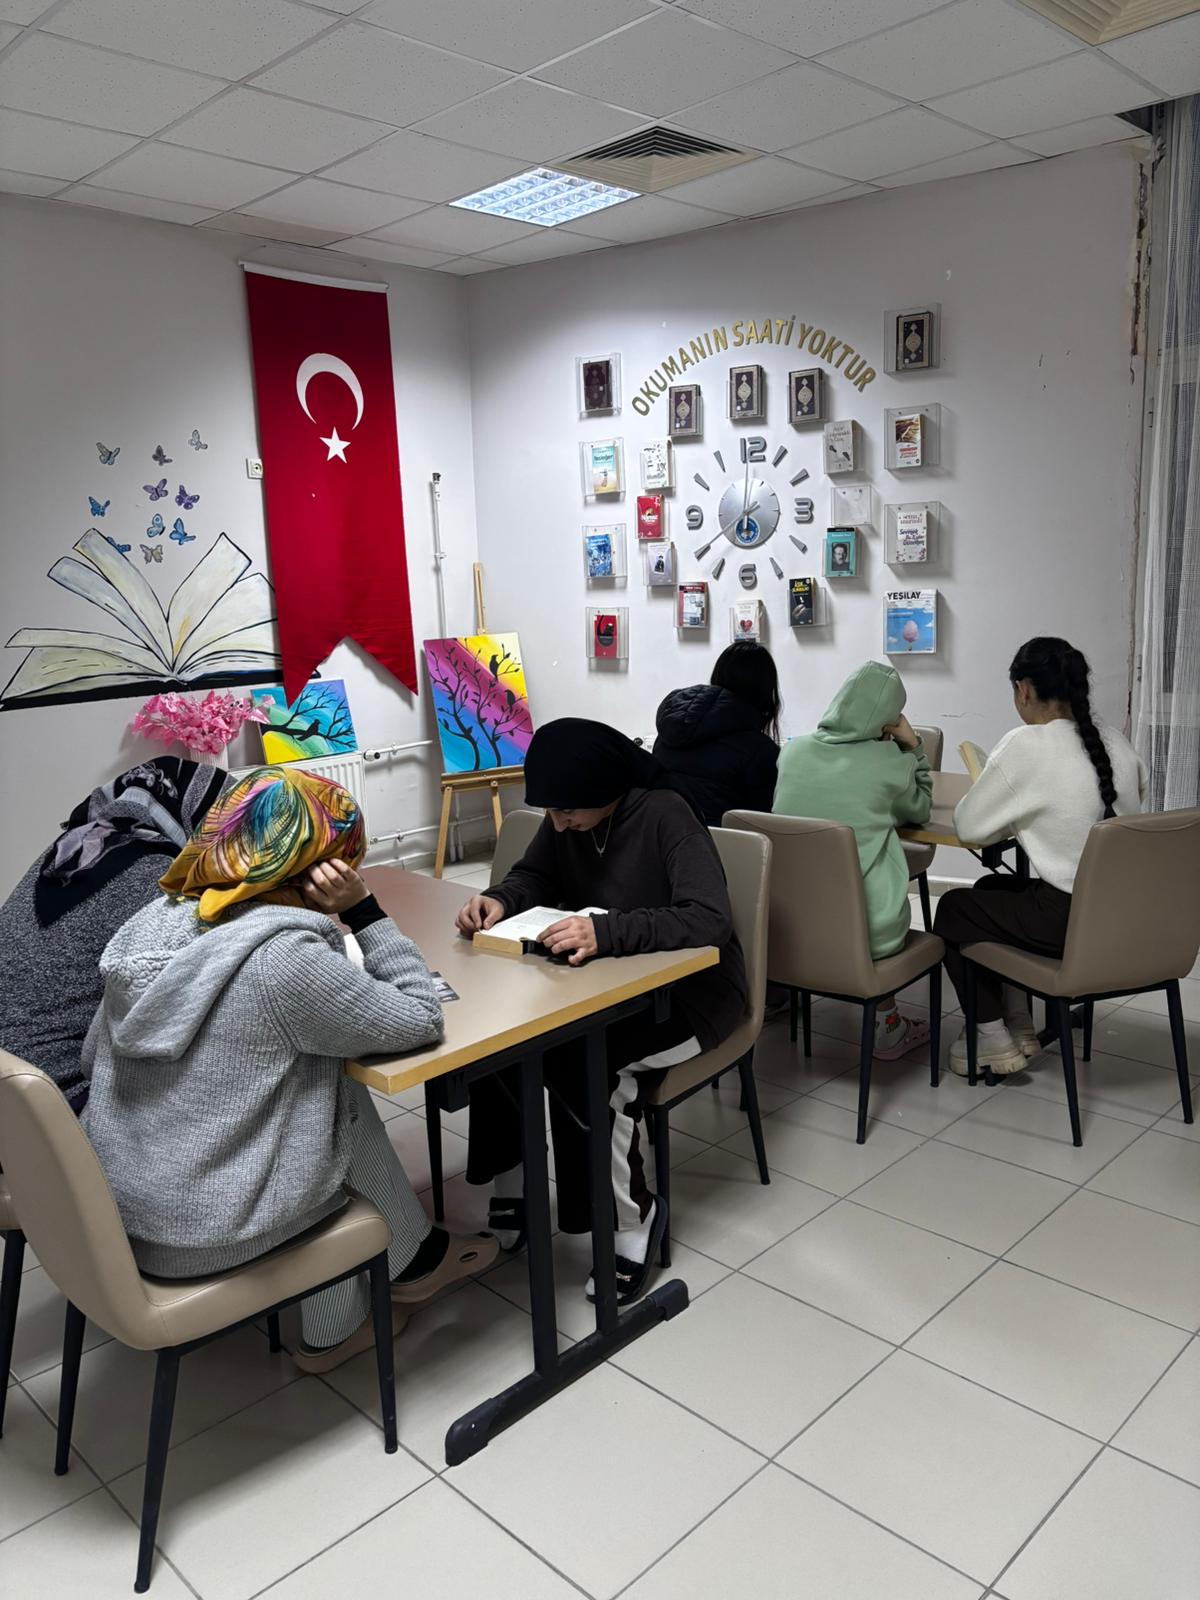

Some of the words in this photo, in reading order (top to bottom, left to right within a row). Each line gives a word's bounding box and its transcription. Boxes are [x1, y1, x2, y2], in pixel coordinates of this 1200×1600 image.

[631, 326, 729, 417] OKUMANIN
[731, 315, 796, 347] SAATİ
[798, 323, 877, 393] YOKTUR
[740, 436, 767, 463] 12
[685, 504, 704, 530] 9
[794, 497, 814, 524] 3
[738, 563, 758, 590] 6
